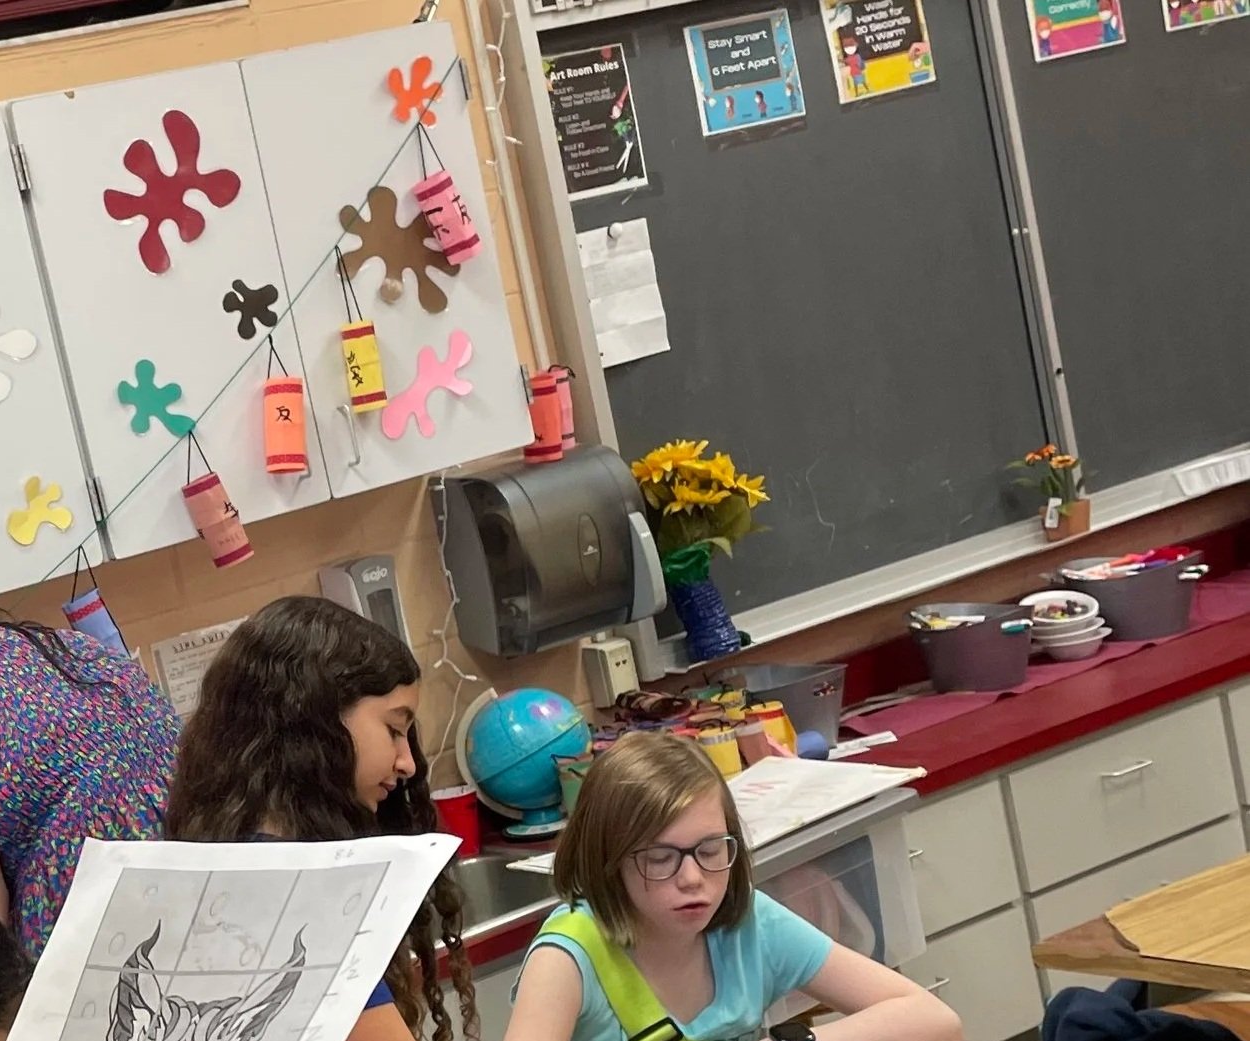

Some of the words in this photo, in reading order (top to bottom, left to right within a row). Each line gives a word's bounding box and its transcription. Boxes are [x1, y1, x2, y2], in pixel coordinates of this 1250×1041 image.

[856, 10, 888, 24] Hands
[889, 6, 904, 16] for
[870, 16, 911, 32] Seconds
[708, 39, 732, 49] Stay
[734, 30, 768, 44] Smart
[875, 28, 906, 41] Warm
[731, 47, 750, 58] and
[871, 39, 903, 53] Water
[550, 72, 565, 82] Art
[567, 66, 593, 78] Room
[594, 61, 619, 73] Rules
[712, 67, 720, 76] 6
[721, 62, 745, 74] Feet
[747, 56, 777, 70] Apart
